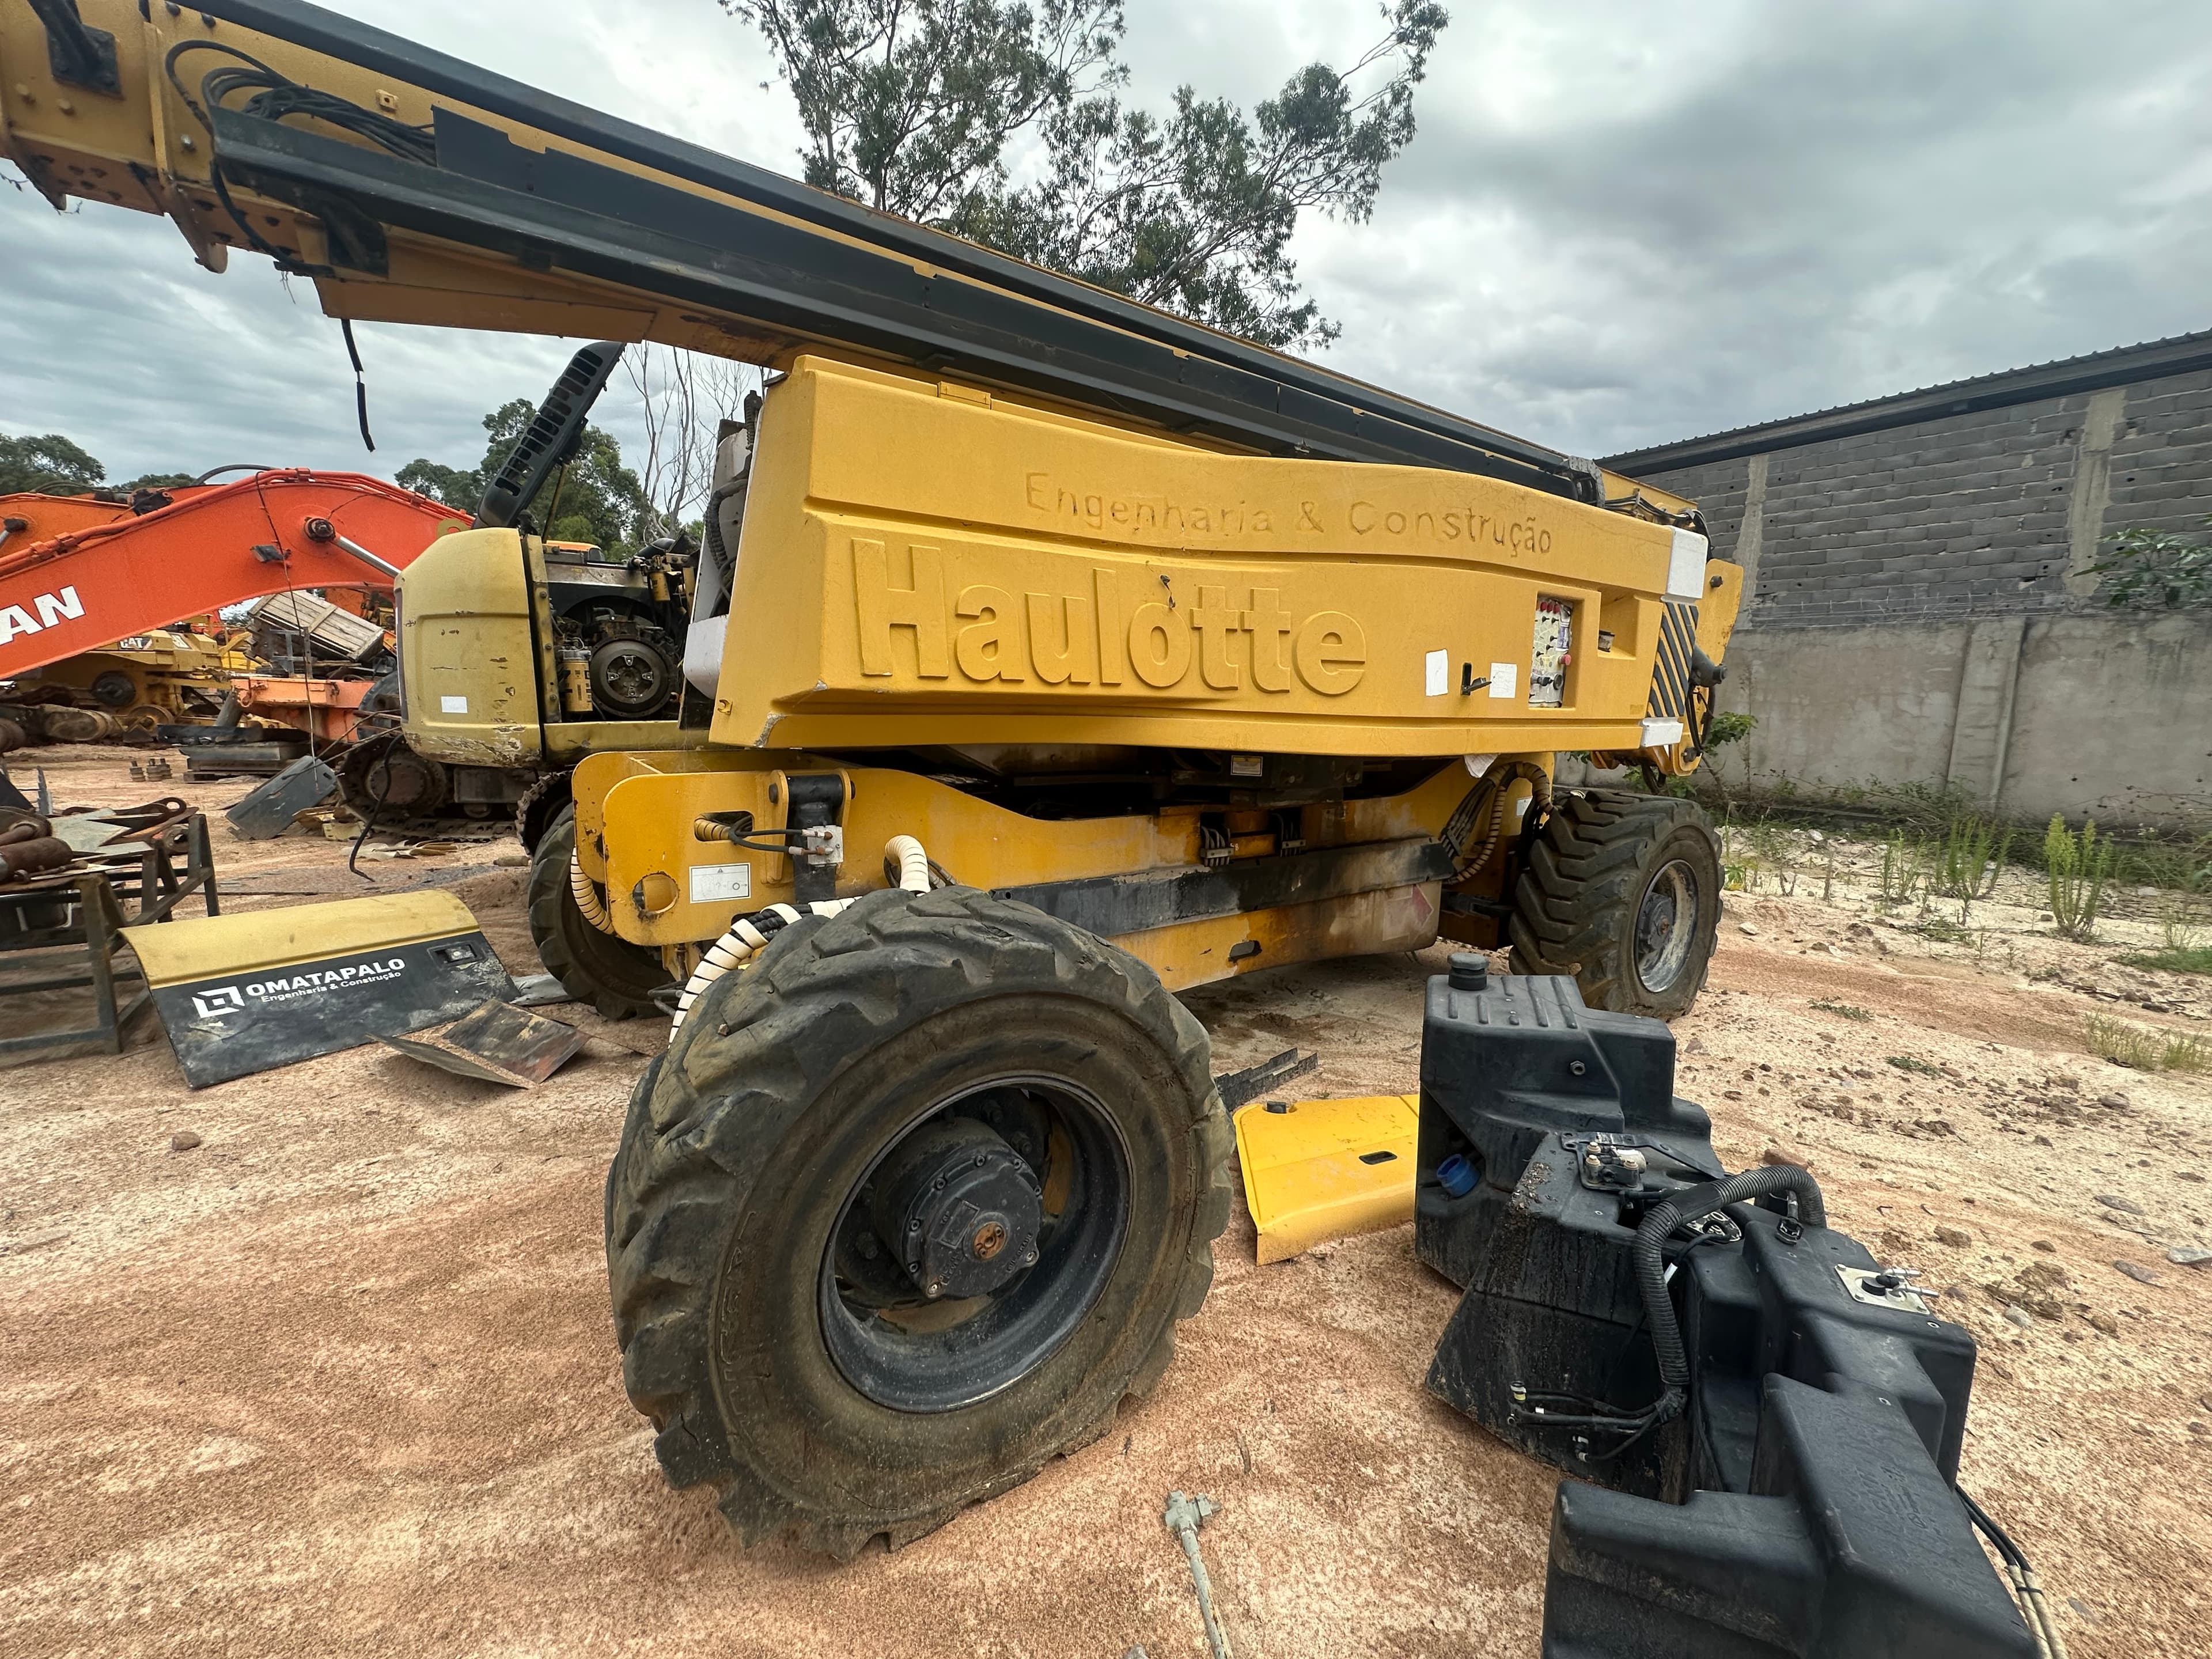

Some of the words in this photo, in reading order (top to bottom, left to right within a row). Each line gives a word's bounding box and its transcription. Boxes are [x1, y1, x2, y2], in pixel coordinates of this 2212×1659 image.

[1026, 472, 1273, 535] Engenharia
[1301, 501, 1324, 533] &
[1349, 500, 1551, 557] Construção
[852, 538, 1366, 695] Haulotte
[120, 637, 142, 649] CAT
[245, 959, 406, 997] OMATAPALO
[261, 986, 327, 1003] Engenharia
[340, 972, 402, 988] Construção
